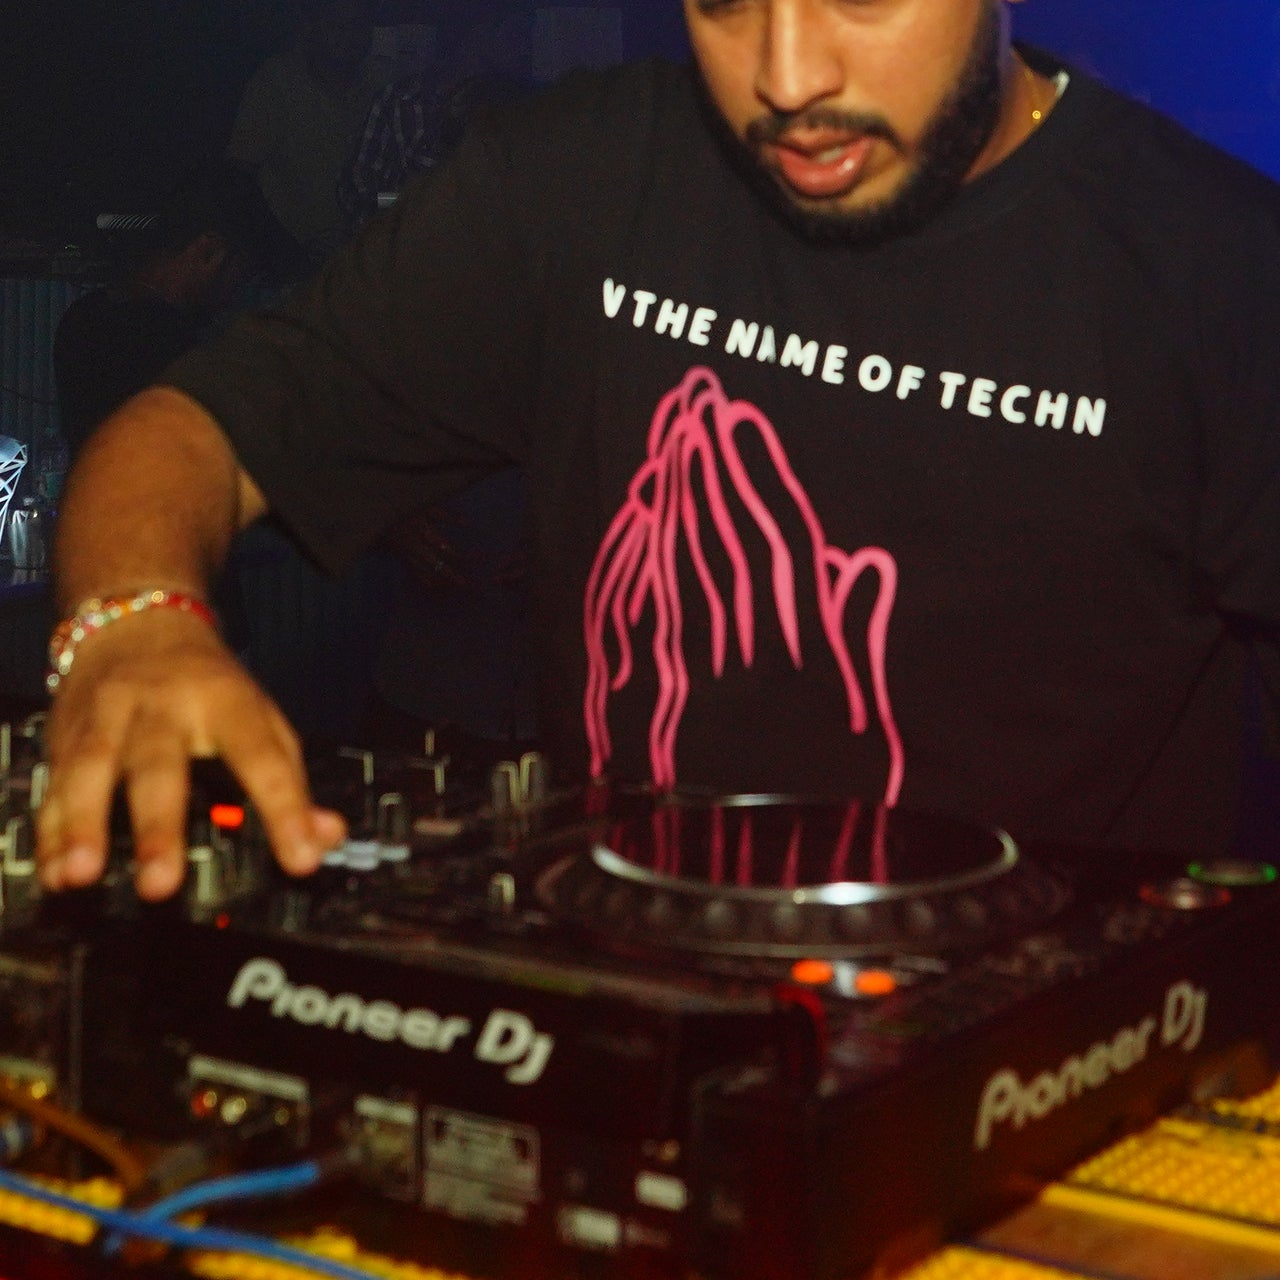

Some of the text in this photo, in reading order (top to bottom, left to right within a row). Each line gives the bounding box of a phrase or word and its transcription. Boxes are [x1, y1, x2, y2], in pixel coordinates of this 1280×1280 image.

[724, 318, 849, 386] NAME
[858, 354, 925, 401] OF
[226, 956, 473, 1054] Pioneer
